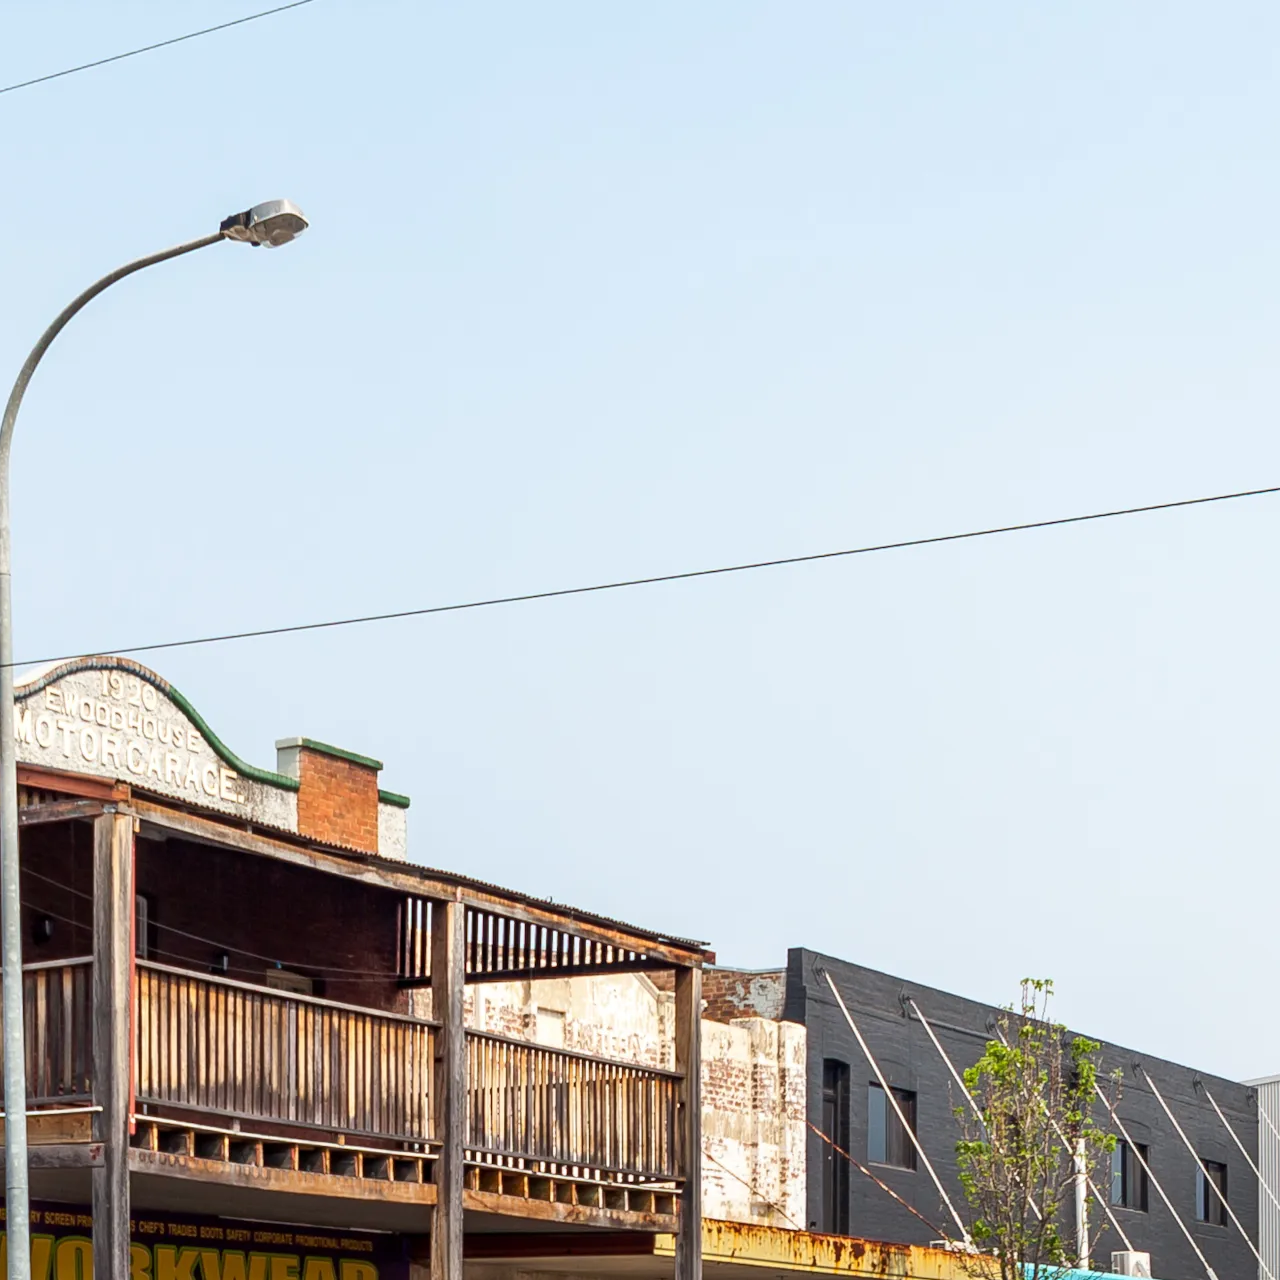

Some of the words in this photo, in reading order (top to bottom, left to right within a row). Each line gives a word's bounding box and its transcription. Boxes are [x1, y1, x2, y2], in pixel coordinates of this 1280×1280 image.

[100, 670, 157, 712] 1920
[14, 705, 119, 770] MOTOR
[44, 1212, 76, 1226] SCREEN
[138, 1221, 165, 1235] CHEF'S
[168, 1223, 197, 1237] TRADIES
[200, 1226, 224, 1240] BOOTS
[226, 1229, 251, 1242] SAFETY
[254, 1231, 293, 1245] CORPORATE
[295, 1234, 340, 1249] PROMOTIONAL
[340, 1238, 373, 1252] PRODUCTS
